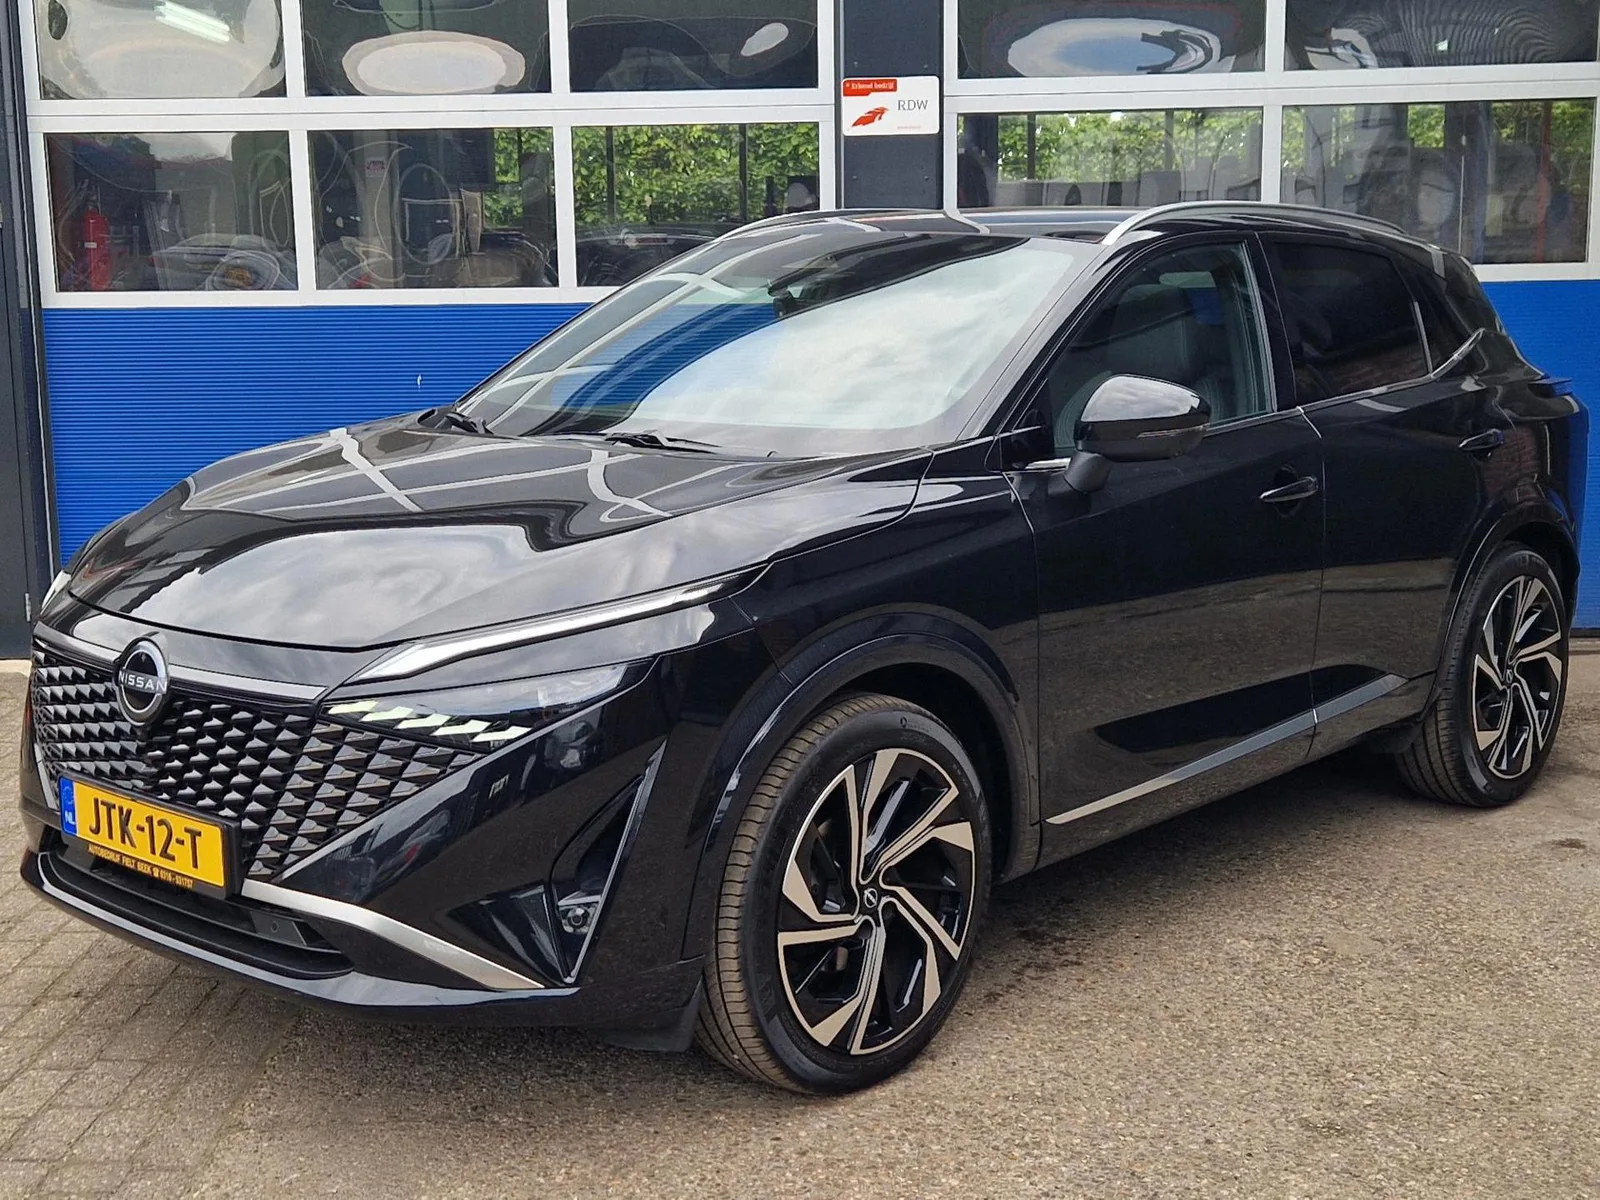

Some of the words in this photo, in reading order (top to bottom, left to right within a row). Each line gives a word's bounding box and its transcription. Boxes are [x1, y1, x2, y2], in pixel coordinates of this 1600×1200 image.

[897, 99, 929, 111] RDW
[119, 670, 168, 692] NISSAN
[64, 810, 76, 825] NL
[89, 797, 202, 869] JTK-12-T
